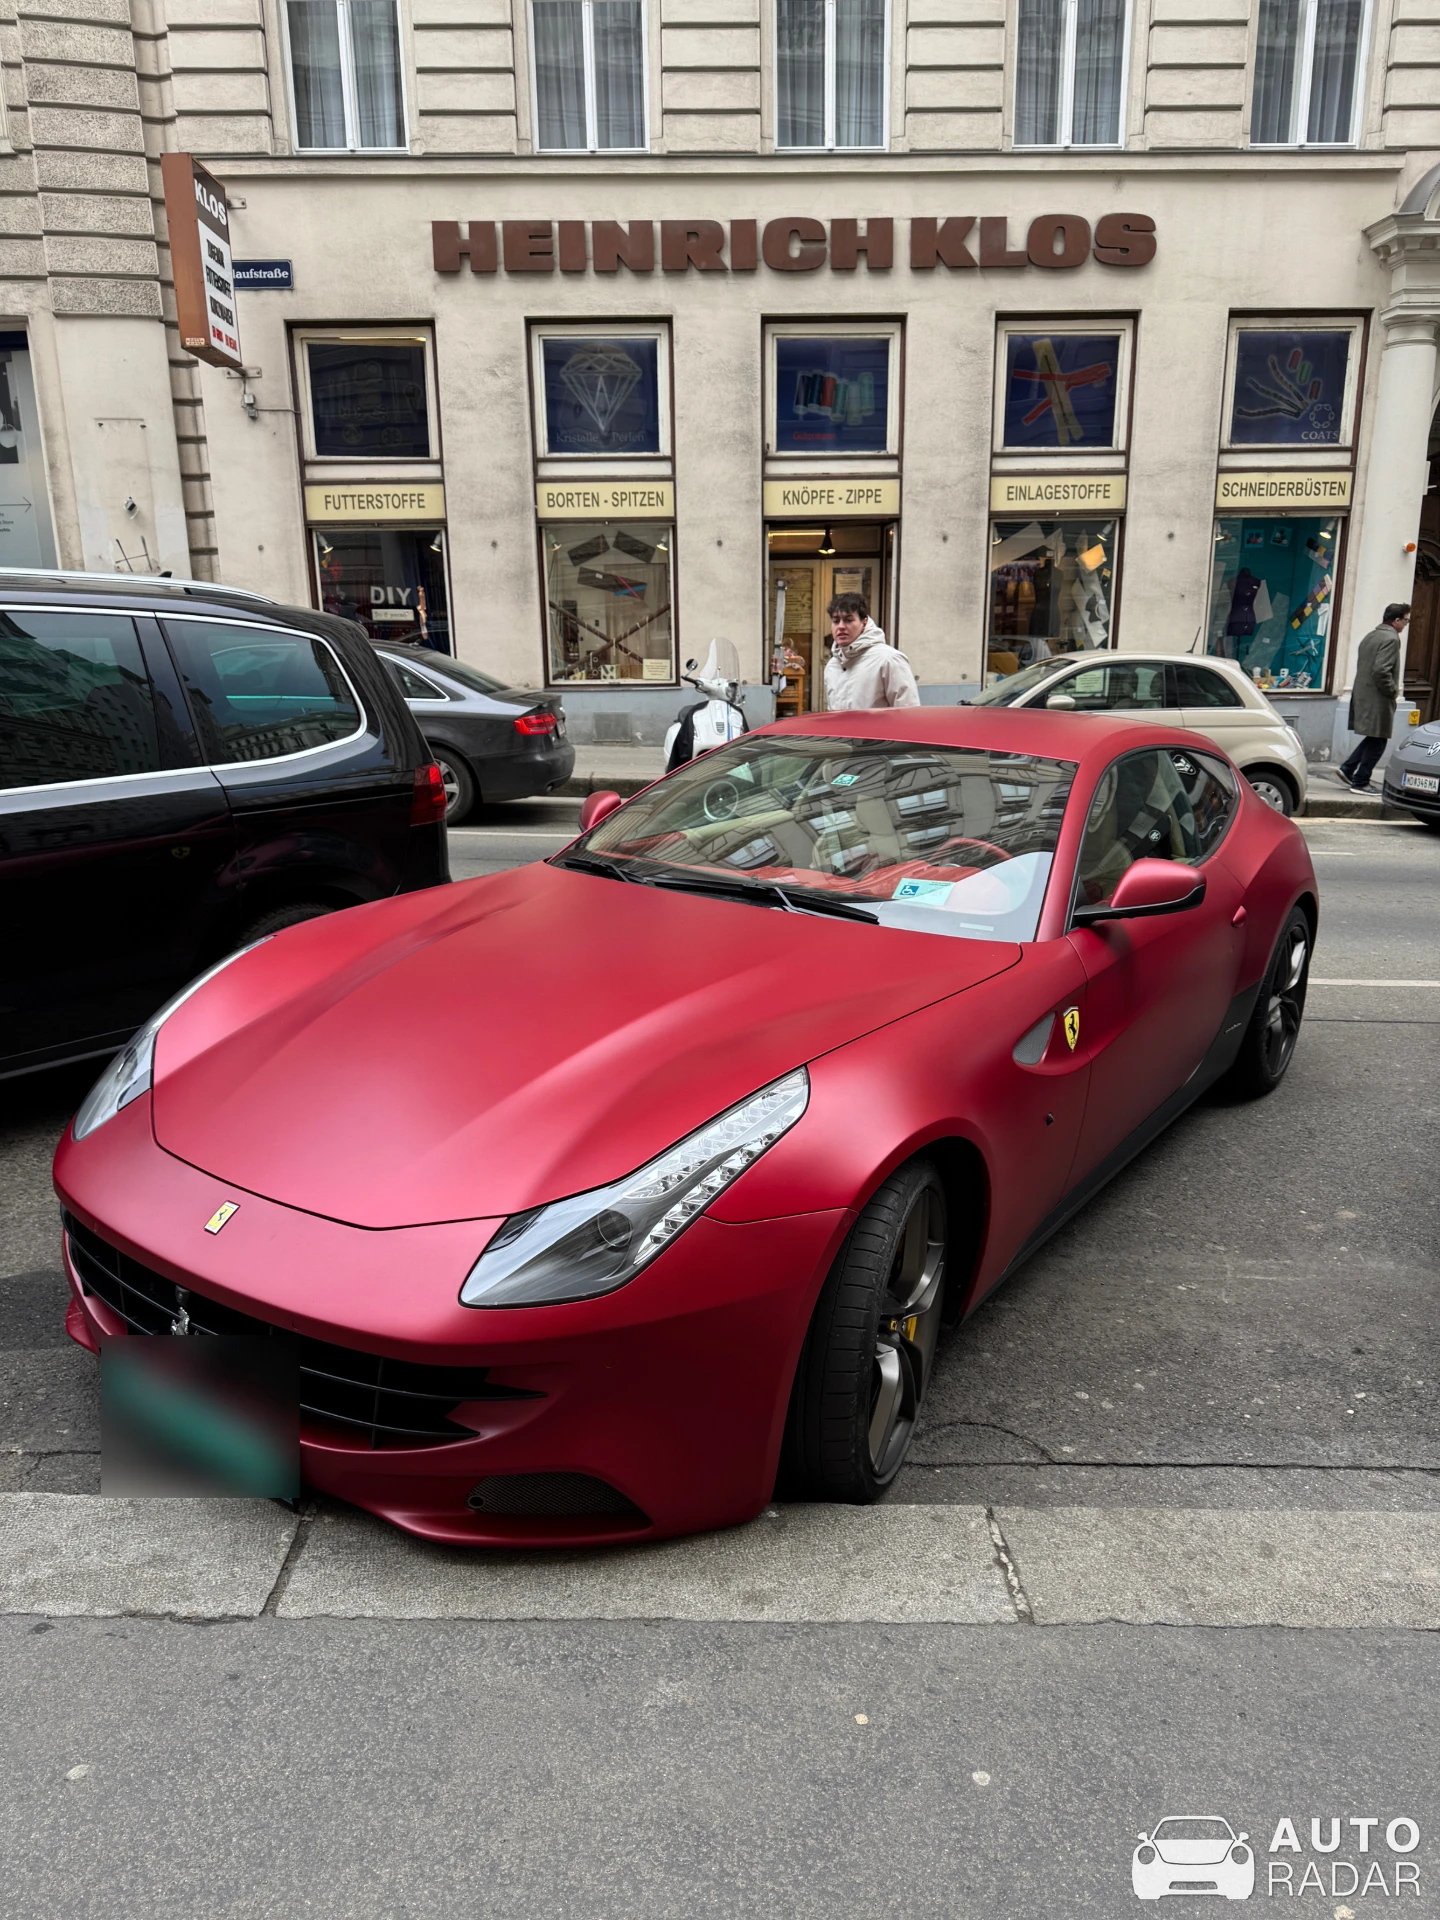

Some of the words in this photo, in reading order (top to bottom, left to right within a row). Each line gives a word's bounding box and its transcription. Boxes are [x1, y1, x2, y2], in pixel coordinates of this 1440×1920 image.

[194, 178, 227, 226] KLOS
[432, 217, 894, 273] HEINRICH
[910, 213, 1157, 272] KLOS
[232, 268, 289, 279] laufstraße
[556, 432, 598, 443] Kristalle
[612, 432, 645, 442] Perlen
[1301, 431, 1339, 440] COATS
[782, 486, 835, 506] KNÖPFE
[845, 488, 882, 505] ZIPPE
[1006, 483, 1111, 502] EINLAGESTOFFE
[1221, 478, 1347, 498] SCHNEIDERBÜSTEN
[324, 493, 426, 511] FUTTERSTOFFE
[546, 491, 600, 509] BORTEN
[611, 490, 664, 508] SPITZEN
[370, 586, 411, 606] DIY
